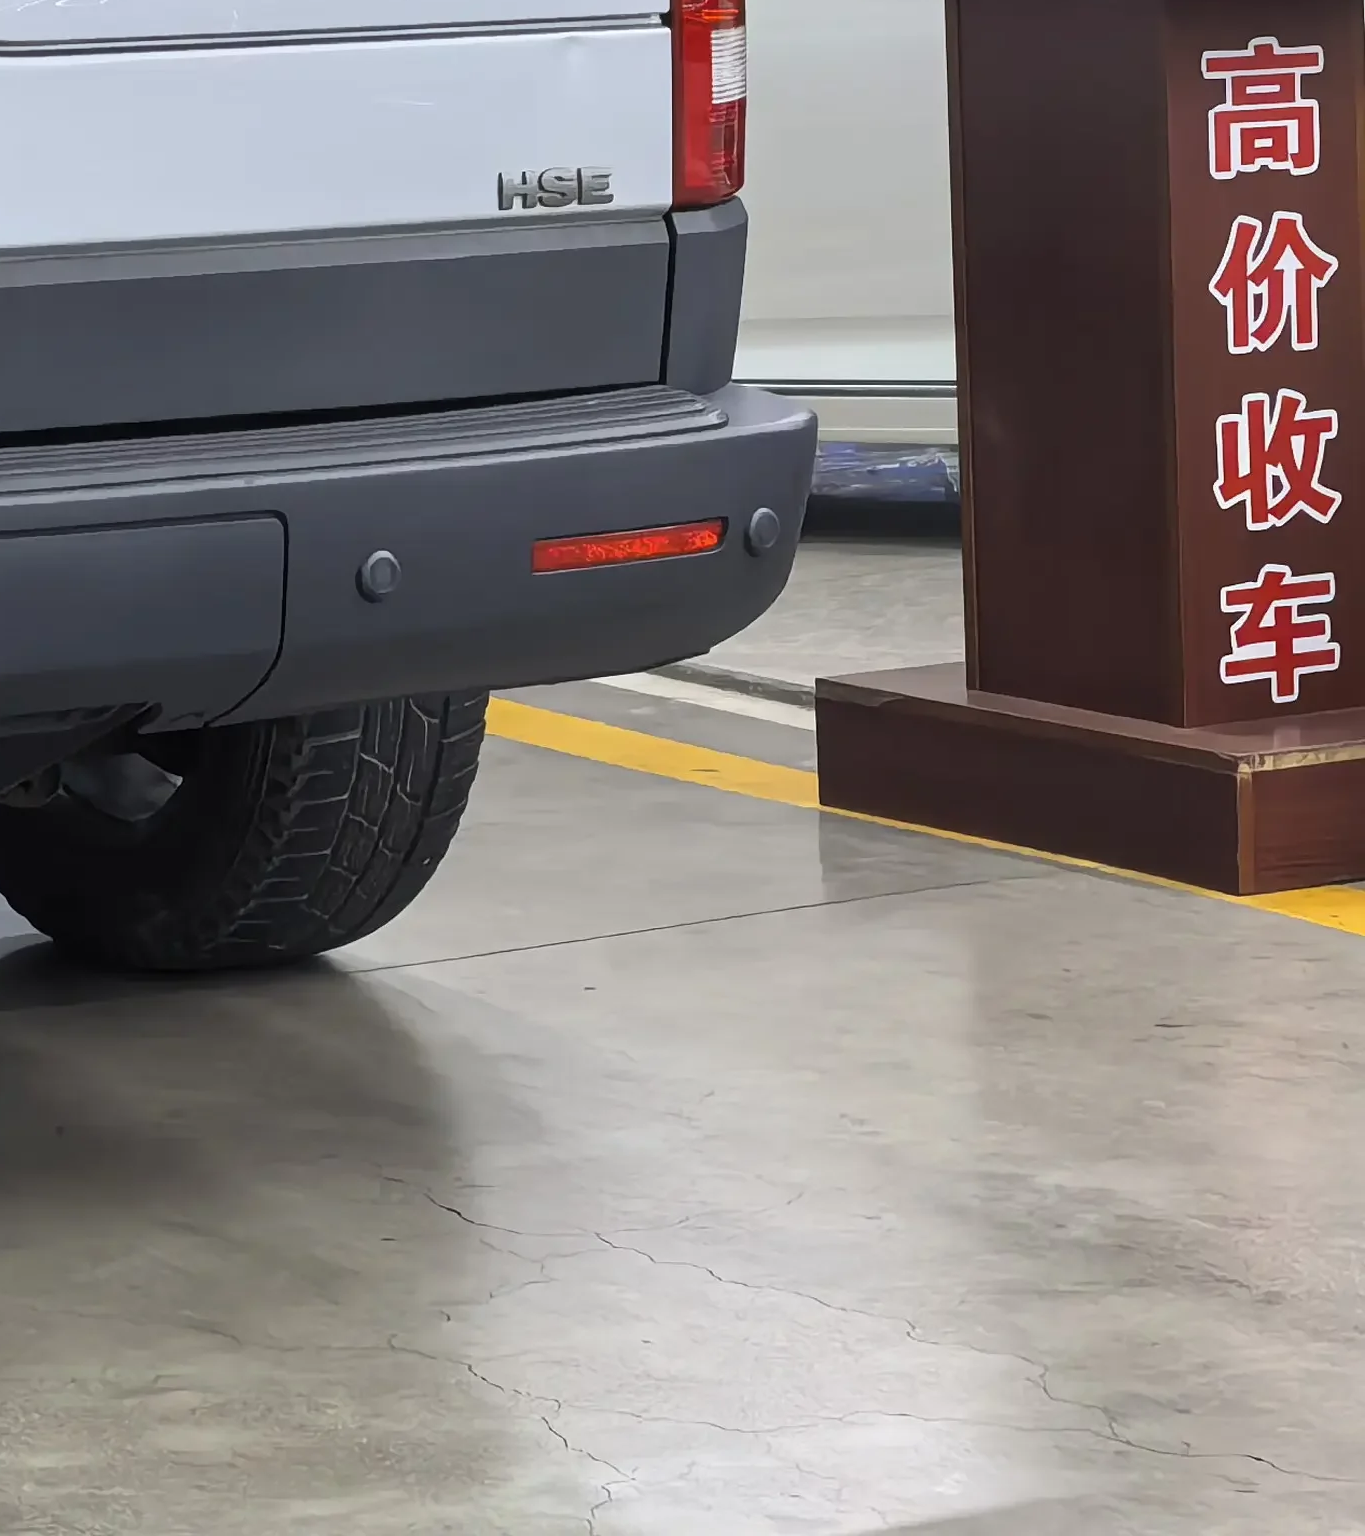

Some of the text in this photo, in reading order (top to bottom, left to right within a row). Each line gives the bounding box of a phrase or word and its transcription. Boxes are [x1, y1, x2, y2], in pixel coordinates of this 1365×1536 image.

[497, 166, 615, 211] HSE
[1201, 37, 1341, 704] 高价收车
